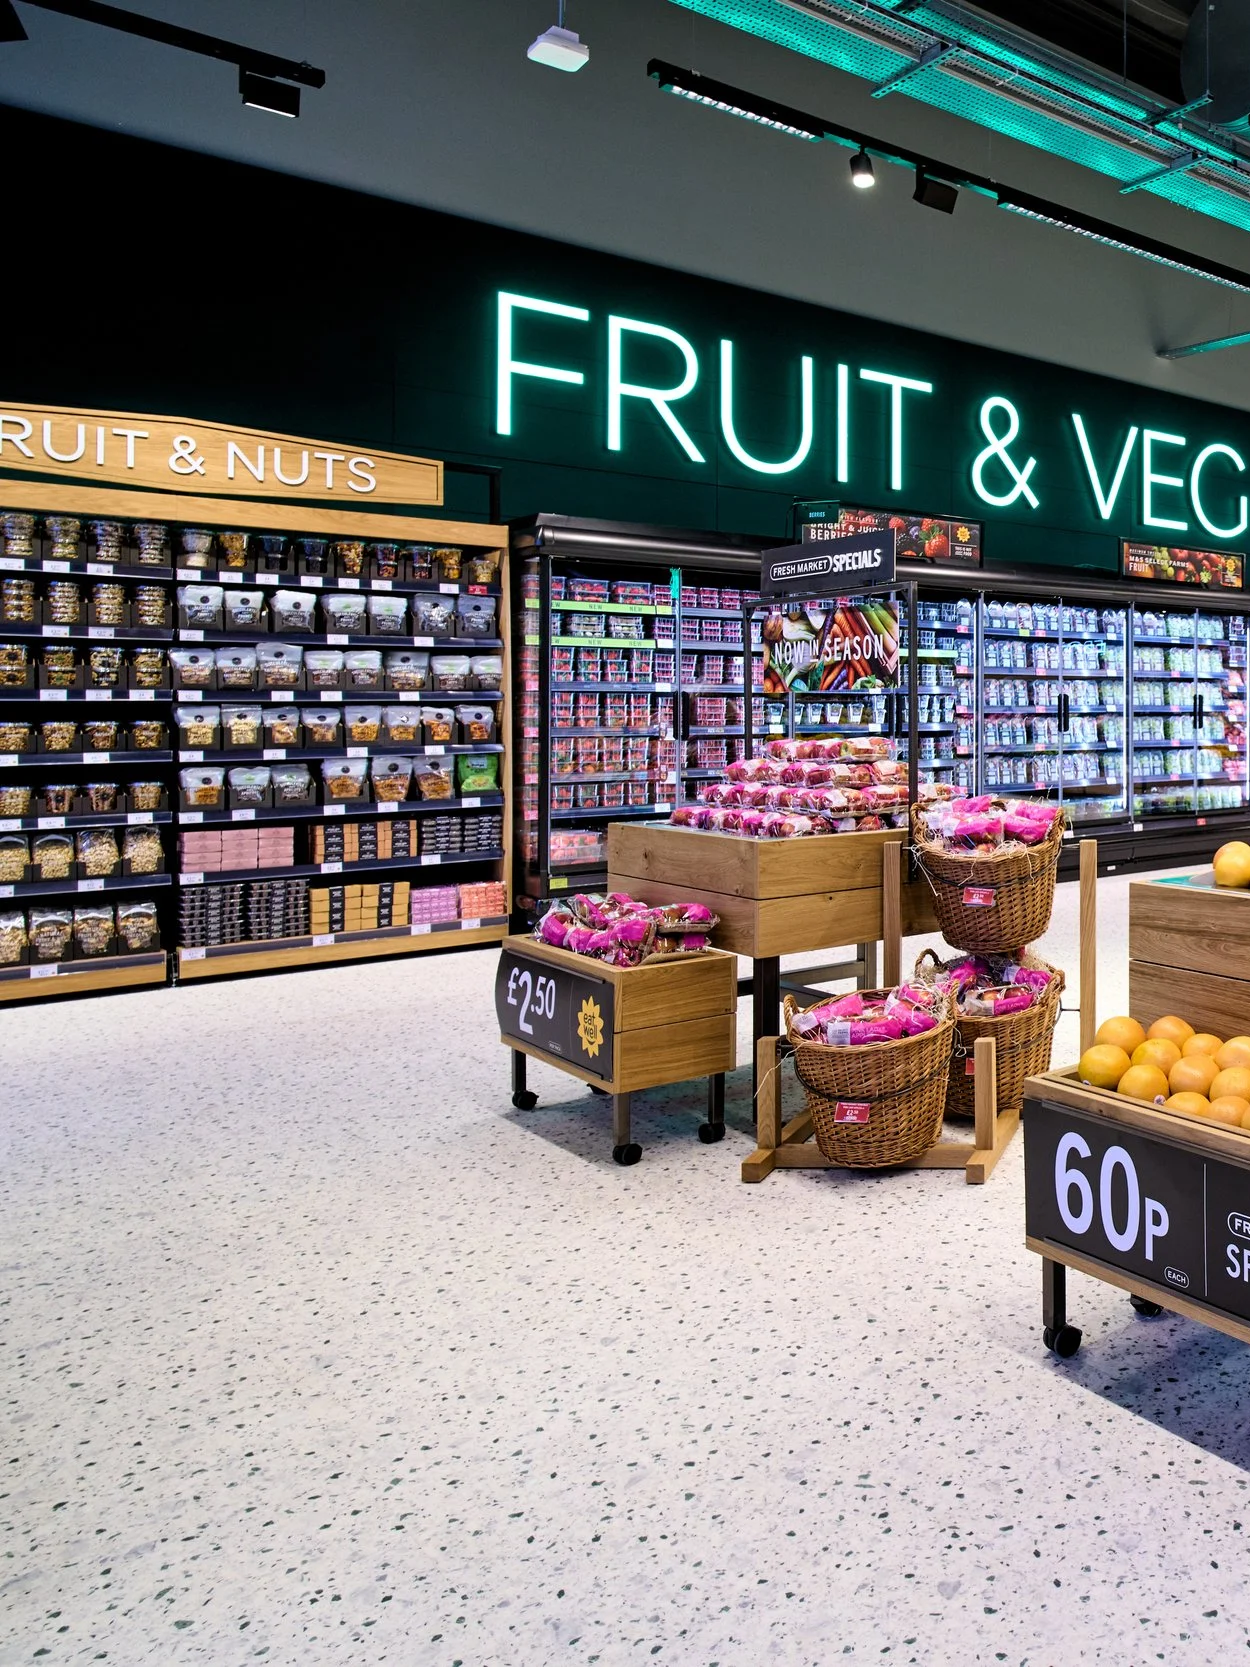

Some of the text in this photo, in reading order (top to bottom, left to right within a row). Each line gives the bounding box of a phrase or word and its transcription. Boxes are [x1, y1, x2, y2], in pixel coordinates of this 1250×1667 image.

[496, 291, 1248, 537] FRUIT & VEG
[168, 436, 206, 475] &
[226, 441, 376, 493] NUTS
[772, 548, 882, 577] FRESH MARKET SPECIALS
[1129, 562, 1149, 572] FRUIT
[774, 634, 884, 664] NOW IN SEASON
[507, 967, 556, 1035] £2.50
[583, 1012, 596, 1024] eat
[584, 1023, 598, 1040] well
[1166, 1270, 1187, 1284] EACH
